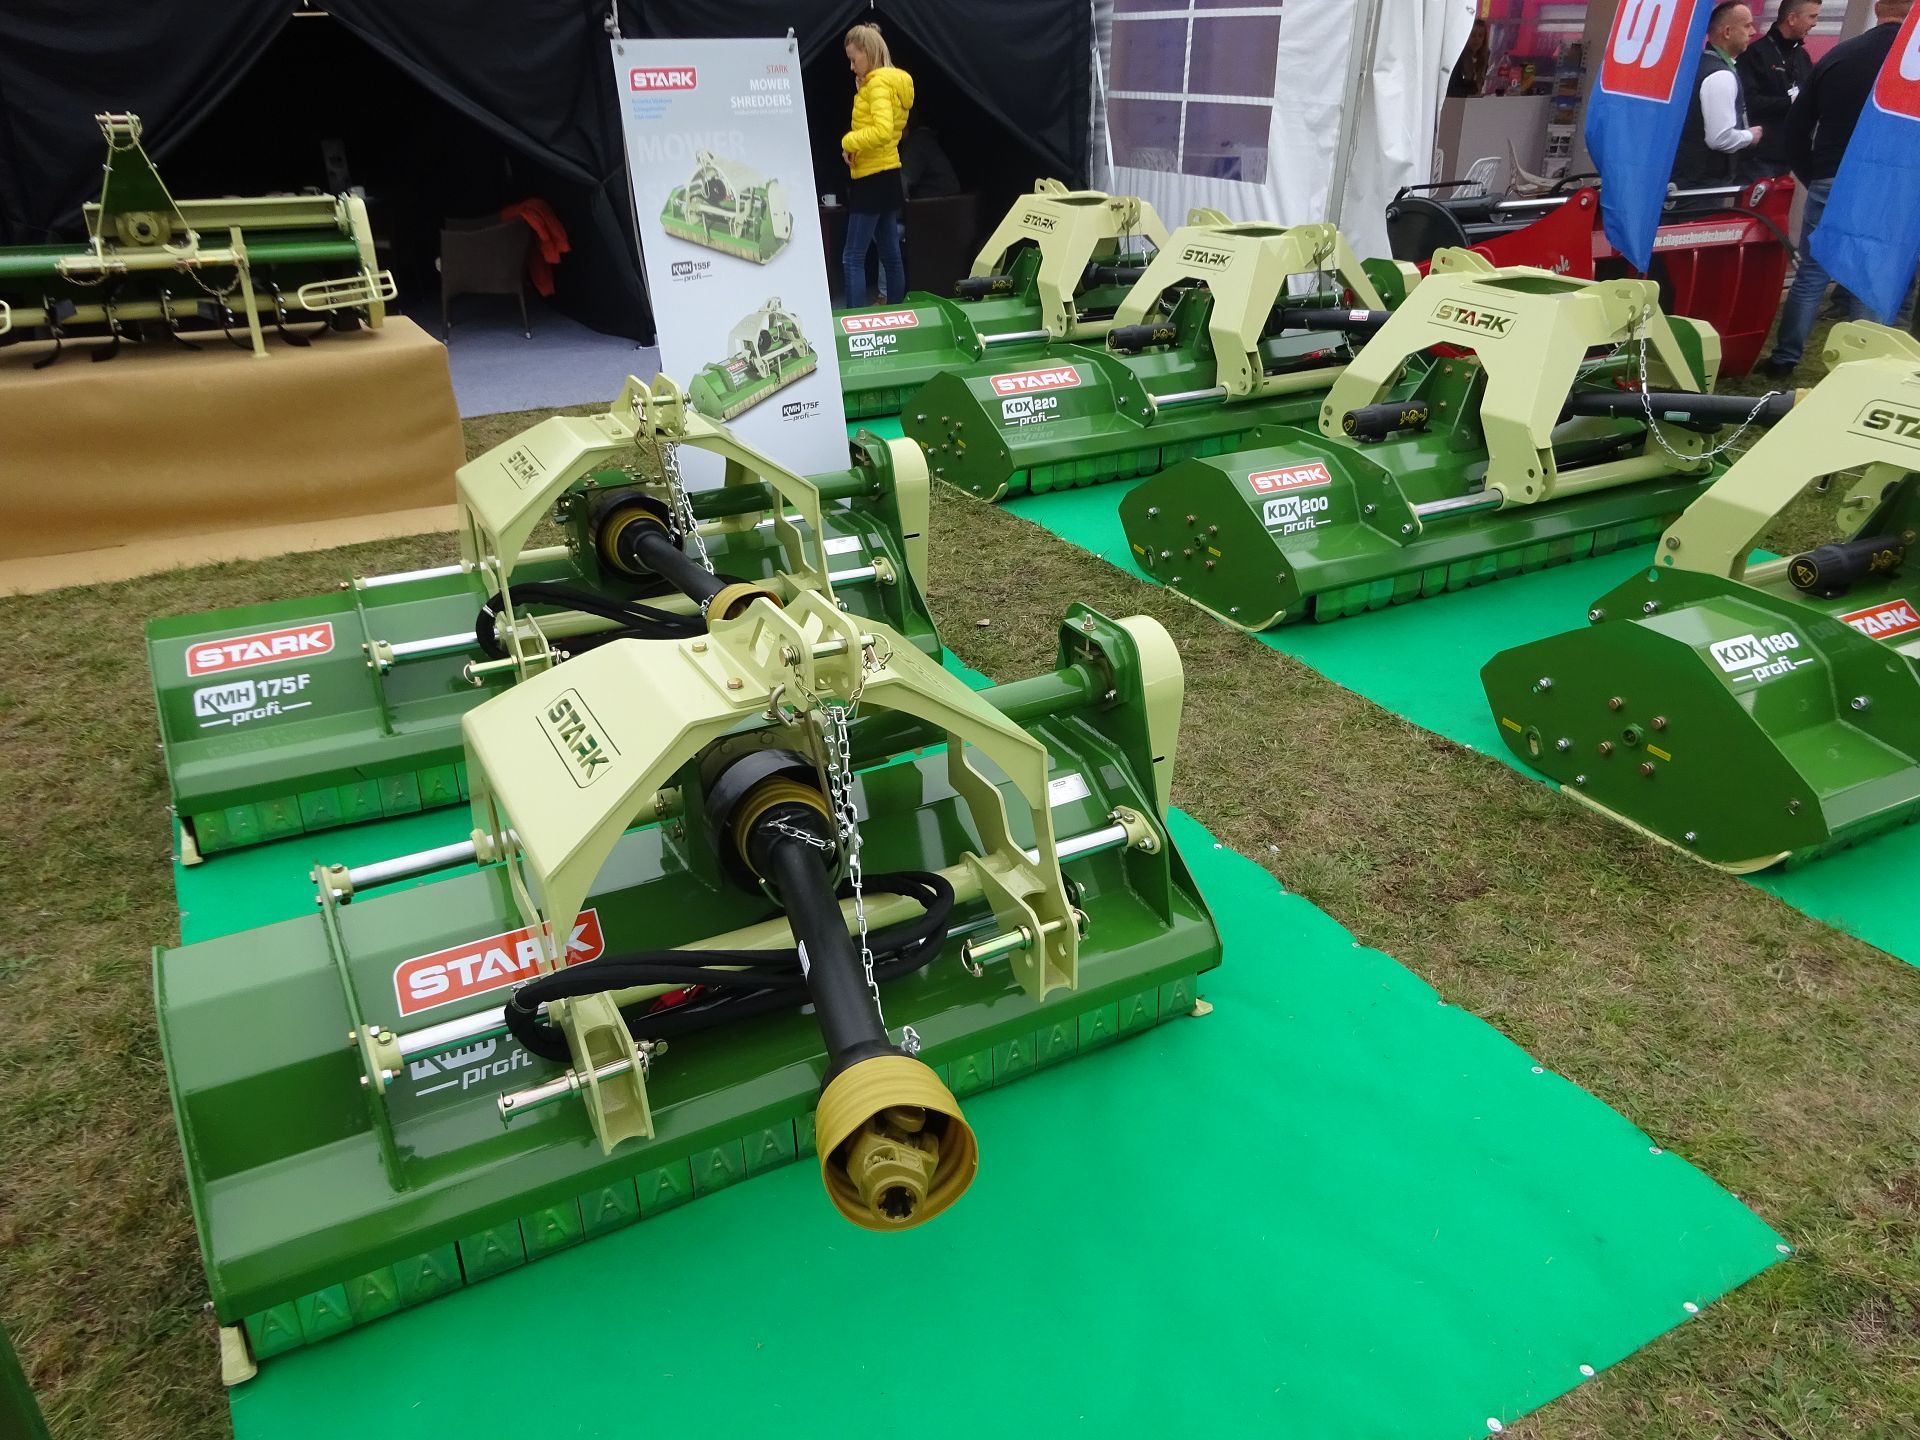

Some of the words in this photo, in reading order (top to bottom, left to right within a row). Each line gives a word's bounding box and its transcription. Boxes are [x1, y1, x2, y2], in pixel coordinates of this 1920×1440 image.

[766, 64, 789, 74] STARK
[633, 71, 695, 88] STARK
[749, 78, 791, 92] MOWER
[730, 94, 793, 110] SHREDDERS
[1022, 213, 1058, 231] STARK
[1182, 249, 1231, 267] STARK
[673, 262, 693, 275] KMH
[683, 272, 702, 283] profi
[847, 314, 914, 330] STARK
[1435, 305, 1512, 333] STARK
[851, 335, 875, 350] KDX
[876, 334, 897, 346] 240
[863, 346, 888, 359] profi
[996, 371, 1078, 391] STARK
[783, 402, 801, 416] KMH
[802, 401, 820, 410] 175F
[1005, 399, 1033, 415] KDX
[1034, 396, 1058, 411] 220
[793, 411, 810, 422] profi
[1019, 411, 1048, 427] profi
[506, 450, 542, 486] STARK
[1254, 467, 1328, 490] STARK
[1267, 500, 1300, 520] KDX
[1301, 496, 1329, 514] 200
[1283, 516, 1317, 536] profi
[1848, 606, 1919, 635] TARK
[195, 629, 328, 669] STARK
[1717, 639, 1768, 665] KDX
[1761, 631, 1800, 655] 180
[1752, 655, 1798, 683] profi
[199, 686, 252, 714] KMH
[256, 674, 311, 699] 175F
[231, 700, 283, 727] profi
[547, 698, 610, 780] STARK
[407, 922, 596, 1001] STARK
